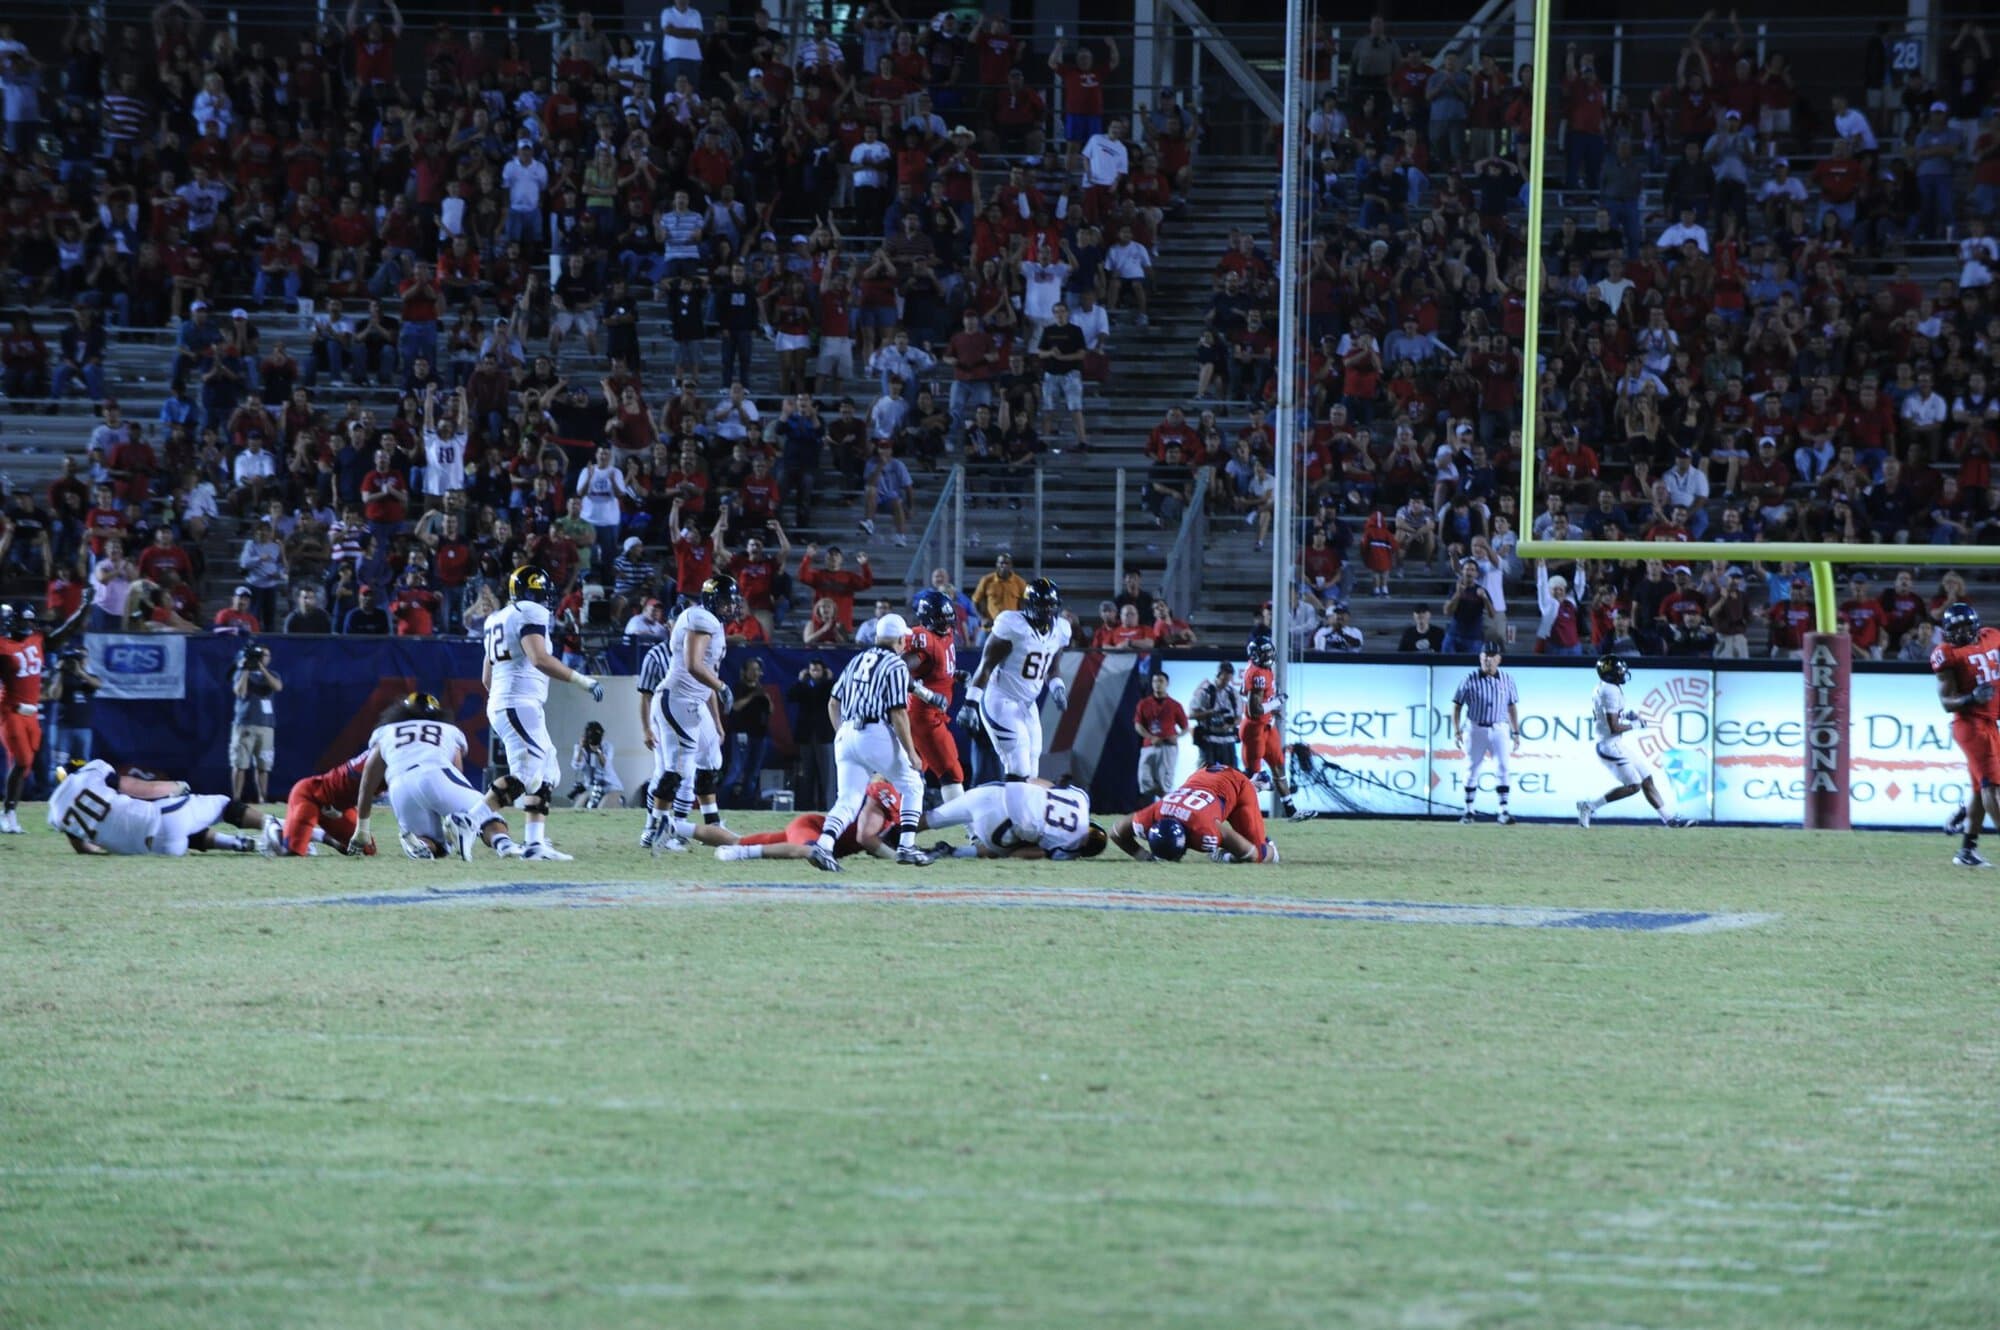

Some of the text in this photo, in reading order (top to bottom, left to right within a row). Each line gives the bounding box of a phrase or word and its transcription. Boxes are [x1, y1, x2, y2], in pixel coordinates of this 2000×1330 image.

[1892, 42, 1920, 69] 28
[438, 447, 454, 464] 10
[14, 646, 41, 678] 15
[853, 651, 878, 683] R
[1288, 709, 1398, 740] SERT
[1809, 644, 1840, 793] ARIZONA
[394, 723, 442, 749] 58
[1743, 778, 1875, 802] CASO
[62, 788, 112, 840] 70
[1044, 791, 1081, 834] 13
